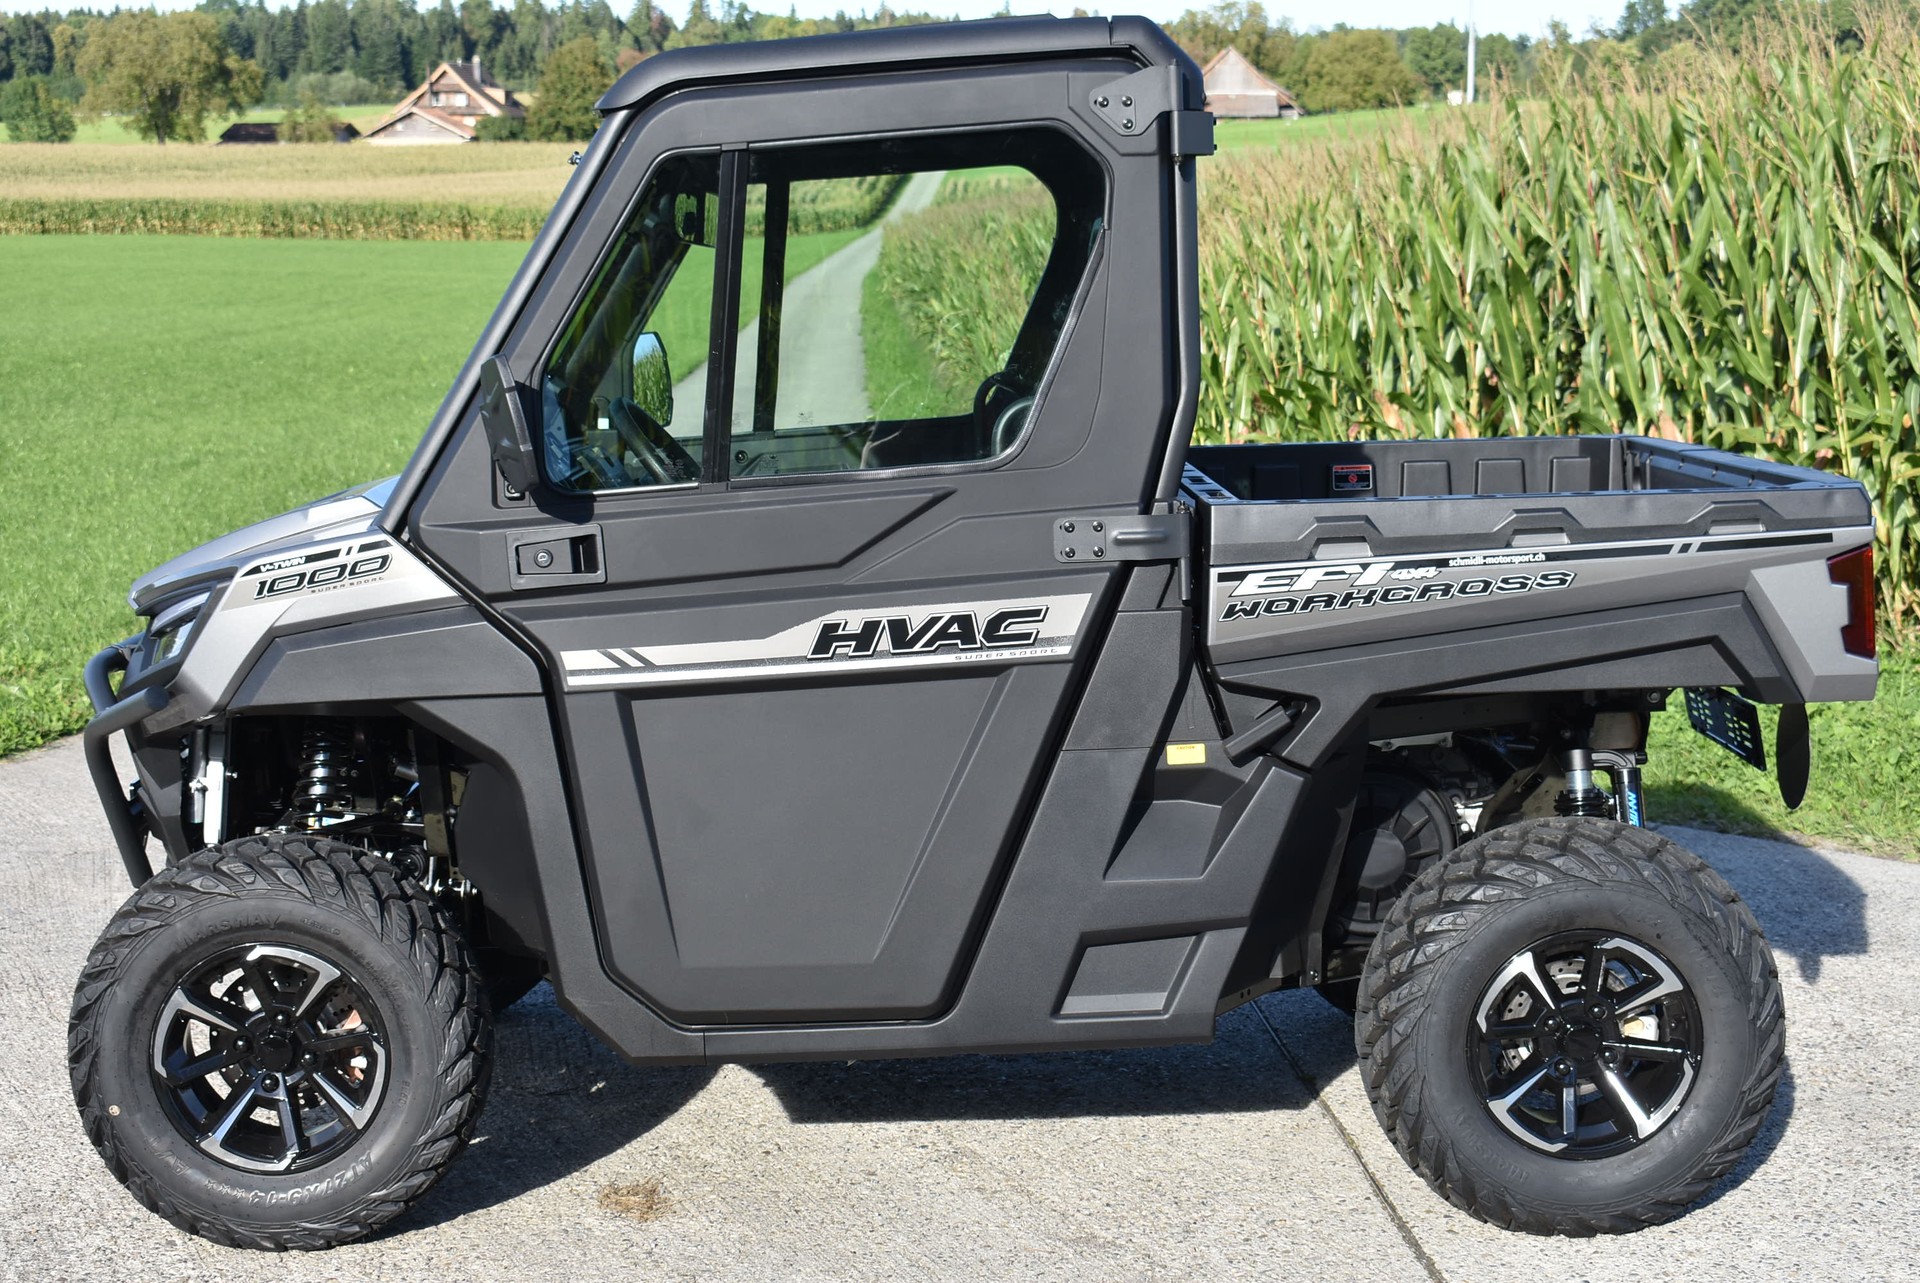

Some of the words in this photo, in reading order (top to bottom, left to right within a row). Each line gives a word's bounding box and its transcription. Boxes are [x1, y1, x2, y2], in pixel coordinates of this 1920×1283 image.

[255, 554, 393, 600] 1000
[259, 556, 307, 573] V-TWIN
[1448, 552, 1546, 567] schmidli-motorsport.ch
[1218, 570, 1578, 622] WORKCROSS
[1229, 562, 1395, 598] EFI
[807, 604, 1050, 660] HVAC
[954, 651, 1004, 661] SUPER
